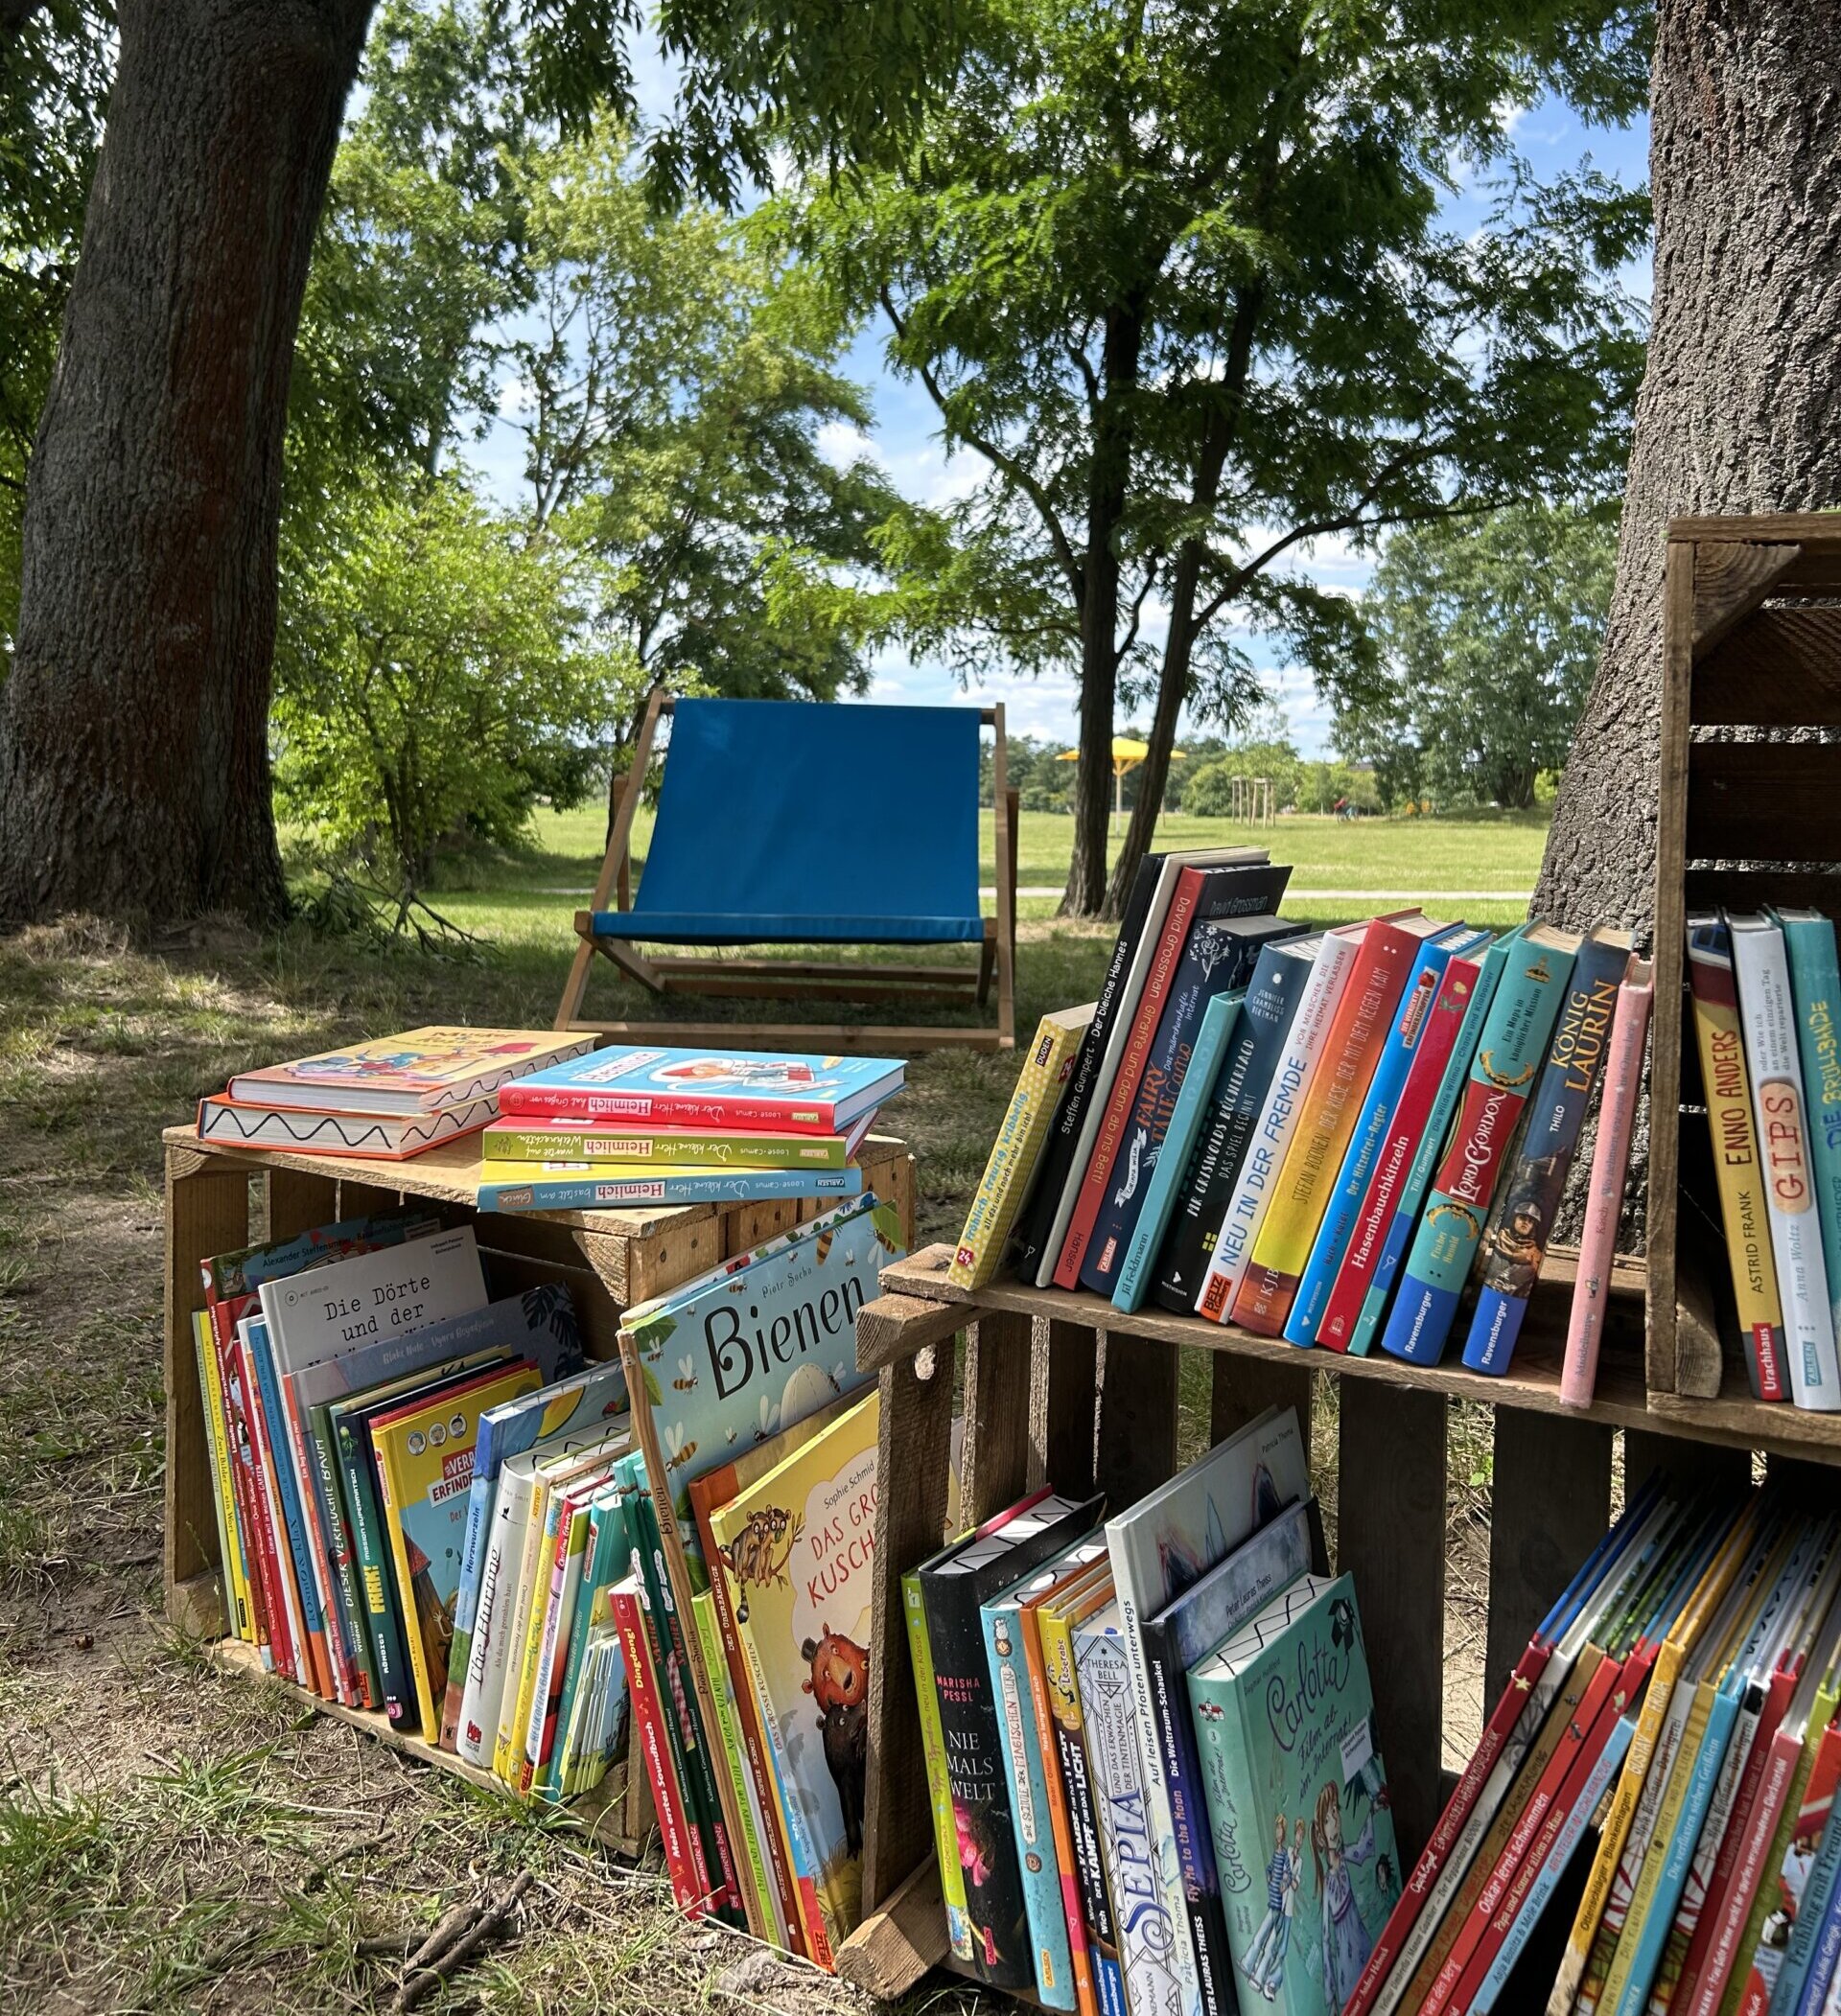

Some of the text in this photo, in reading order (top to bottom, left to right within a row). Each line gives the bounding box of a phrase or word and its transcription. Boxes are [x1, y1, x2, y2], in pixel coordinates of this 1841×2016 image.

[1368, 966, 1388, 987] KAM
[1184, 985, 1199, 1020] Internat
[1293, 964, 1329, 1047] VON MENSCHEN, DIE
[1305, 950, 1345, 1050] IHRE HEIMAT VERLASSEN
[1357, 988, 1381, 1020] REGEN
[1037, 1036, 1051, 1064] DUDEN
[1060, 940, 1127, 1133] Steffen Gumpert Der bleiche Hannes
[1342, 1040, 1363, 1059] MIT
[1349, 1019, 1369, 1041] DEM
[1550, 991, 1587, 1067] KÖNIG
[1565, 981, 1615, 1090] LAURIN
[1165, 1043, 1194, 1095] Camp
[1335, 1060, 1356, 1080] DER
[1809, 1000, 1841, 1104] BRÜLLBANDE
[1065, 896, 1190, 1271] David Grossman Giraffe und dann ab ins Bett! Hanser
[1136, 1062, 1169, 1126] FAIRY
[1186, 1039, 1253, 1217] MR GRISWOLDS BÜCHERJAGD
[1218, 1093, 1256, 1178] DAS SPIEL BEGINNT
[1317, 1109, 1338, 1129] DER
[1549, 1105, 1564, 1131] THILO
[517, 1135, 582, 1147] Weihnachten
[525, 1147, 573, 1158] wartet auf
[586, 1141, 732, 1162] Der kleine Herr Heimlich
[1220, 1057, 1306, 1265] NEU IN DER FREMDE
[1304, 1132, 1330, 1170] BOONEN
[1345, 1103, 1386, 1194] Der Hitzefrei-Regler
[1449, 1093, 1505, 1200] LORD GORDON
[816, 1178, 845, 1187] CARLSEN
[965, 1091, 1029, 1241] Fröhlich, traurig, kribbelig,
[1292, 1170, 1317, 1204] STEFAN
[1352, 1136, 1408, 1267] Hasenbauchkitzeln
[1712, 1029, 1776, 1390] Urachhaus ASTRID FRANK ENNO ANDERS
[958, 1248, 973, 1265] 24
[1098, 1237, 1117, 1271] CARLSEN
[1765, 1097, 1819, 1384] CARLSEN Anna Woltz GIPS
[761, 1265, 812, 1299] Piotr Socha
[1121, 1233, 1148, 1296] Jil Feldmann
[1259, 1266, 1281, 1296] KJB
[324, 1276, 431, 1321] Die Dörte
[1201, 1275, 1223, 1311] BELTZ
[341, 1304, 424, 1341] und der
[703, 1276, 865, 1401] Bienen
[1404, 1291, 1431, 1353] Ravensburger
[1480, 1301, 1506, 1363] Ravensburger
[449, 1450, 477, 1474] VERR
[824, 1462, 875, 1509] Sophie Schmid
[315, 1439, 354, 1607] DIESER VERFLUCHTE BAUM
[465, 1507, 479, 1573] Herzwurzeln
[811, 1516, 845, 1562] DAS
[349, 1620, 362, 1652] Wildner
[471, 1549, 501, 1686] The Hurting
[623, 1628, 643, 1687] Dingdong!
[1085, 1657, 1129, 1671] THERESA
[1098, 1670, 1119, 1680] BELL
[936, 1675, 980, 1689] MARISHA
[944, 1688, 974, 1703] PESSL
[1266, 1633, 1340, 1753] Carlotta
[1153, 1660, 1175, 1757] Weltraum-Schaukel
[645, 1722, 664, 1786] Soundbuch
[947, 1731, 980, 1752] NIE
[1102, 1697, 1121, 1793] UND DAS ERWACHEN
[1113, 1703, 1132, 1789] DER TINTENMAGIE
[946, 1755, 994, 1775] MALS
[1167, 1760, 1179, 1776] Die
[661, 1790, 672, 1824] erstes
[950, 1779, 995, 1802] WELT
[1057, 1639, 1109, 1935] Wich DER KAMPF UM DAS LICHT Leserabe
[1123, 1600, 1193, 1984] Patricia Thoma Auf leisen Pfoten unterwegs
[1174, 1790, 1185, 1819] Moon
[1577, 1683, 1671, 1932] Ottenschläger Blankenhagen GUSTAV FRIDA
[669, 1827, 680, 1857] Mein
[1177, 1823, 1189, 1843] the
[1181, 1847, 1192, 1859] to
[1216, 1814, 1251, 1895] Carlotta
[1476, 1791, 1550, 1913] Oskar lernt schwimmen
[1103, 1786, 1174, 1953] SEPIA
[1184, 1879, 1200, 1902] Fly
[1193, 1913, 1208, 1954] THEISS
[1038, 1948, 1055, 1987] CARLSEN
[1200, 1954, 1216, 1994] LAURAS
